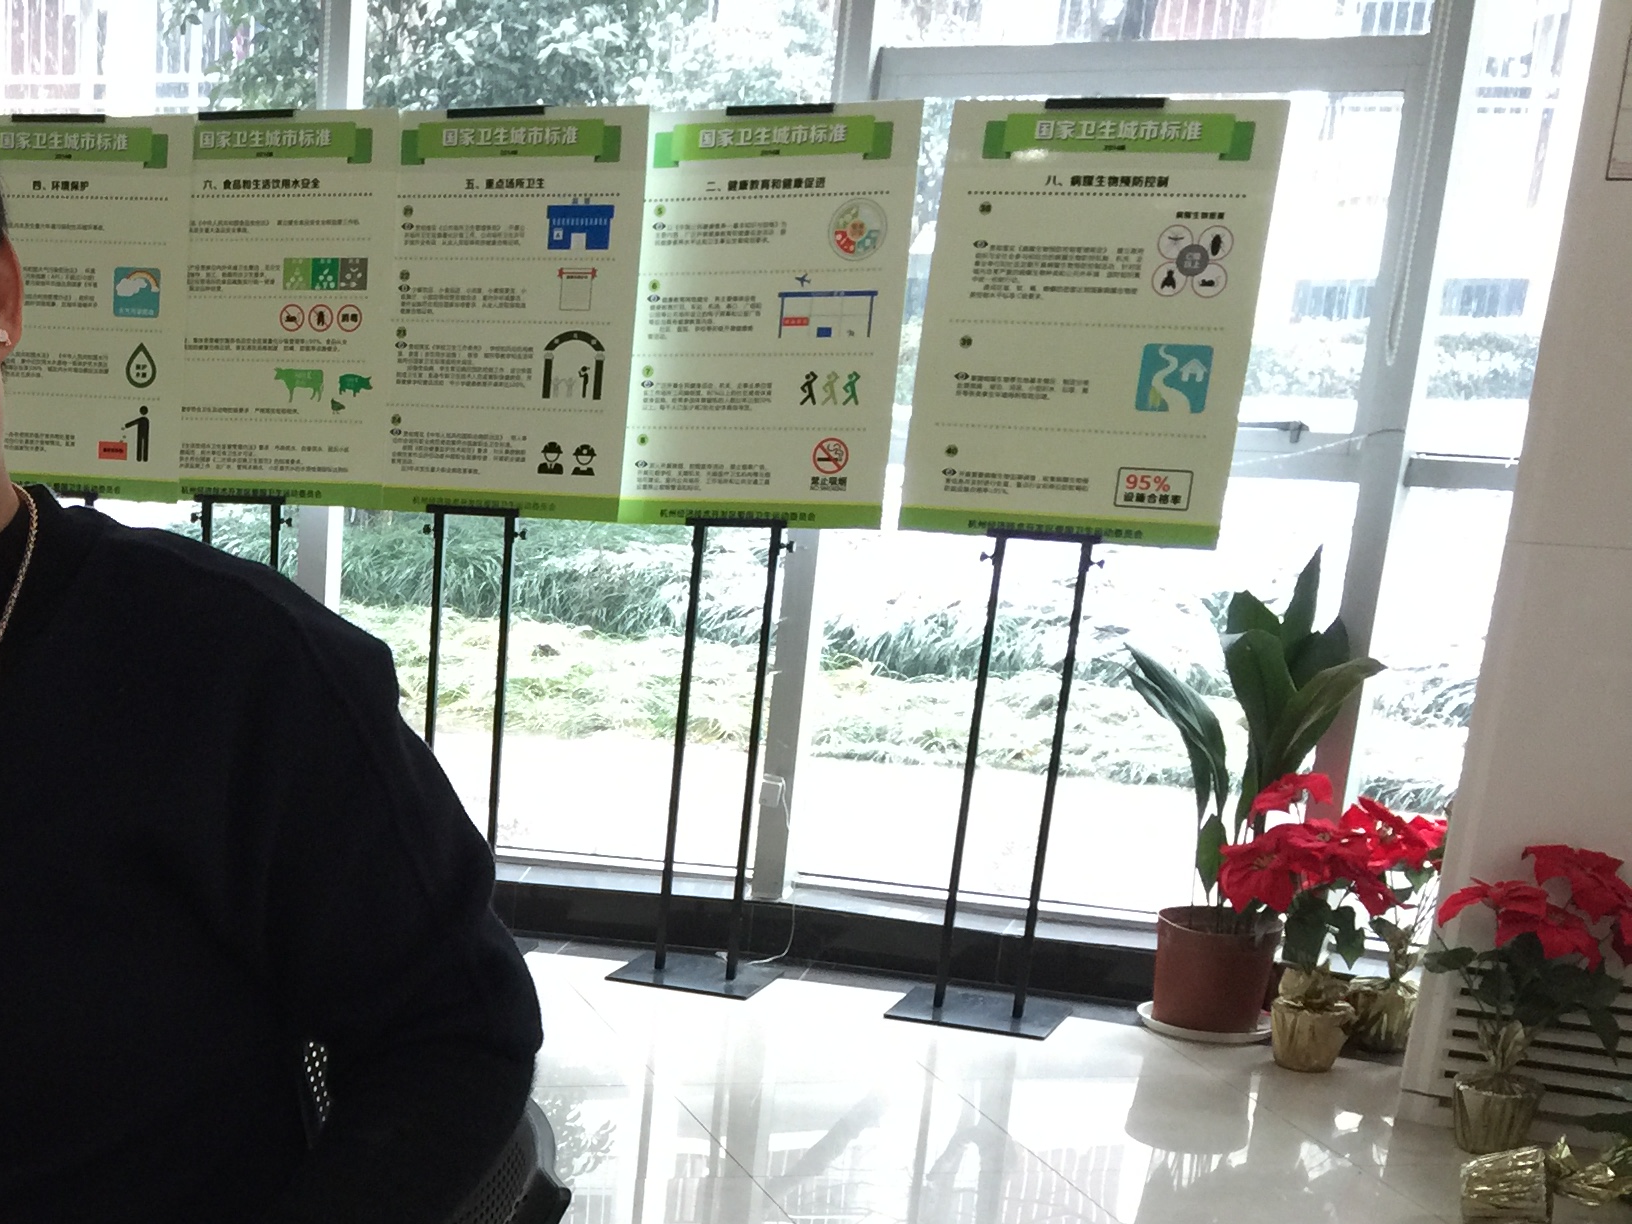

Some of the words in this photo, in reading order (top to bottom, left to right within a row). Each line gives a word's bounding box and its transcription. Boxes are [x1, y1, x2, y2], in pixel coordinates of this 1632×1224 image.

[0, 131, 128, 151] 国家卫生城市标准
[199, 128, 331, 149] 国家卫生城市标准
[442, 126, 579, 147] 国家卫生城市标准
[699, 124, 847, 148] 国家卫生城市标准
[1034, 120, 1203, 142] 国家卫生城市标准
[32, 180, 89, 191] 四、环境保护
[465, 178, 545, 190] 五、重点场所卫生
[1125, 474, 1171, 492] 95%
